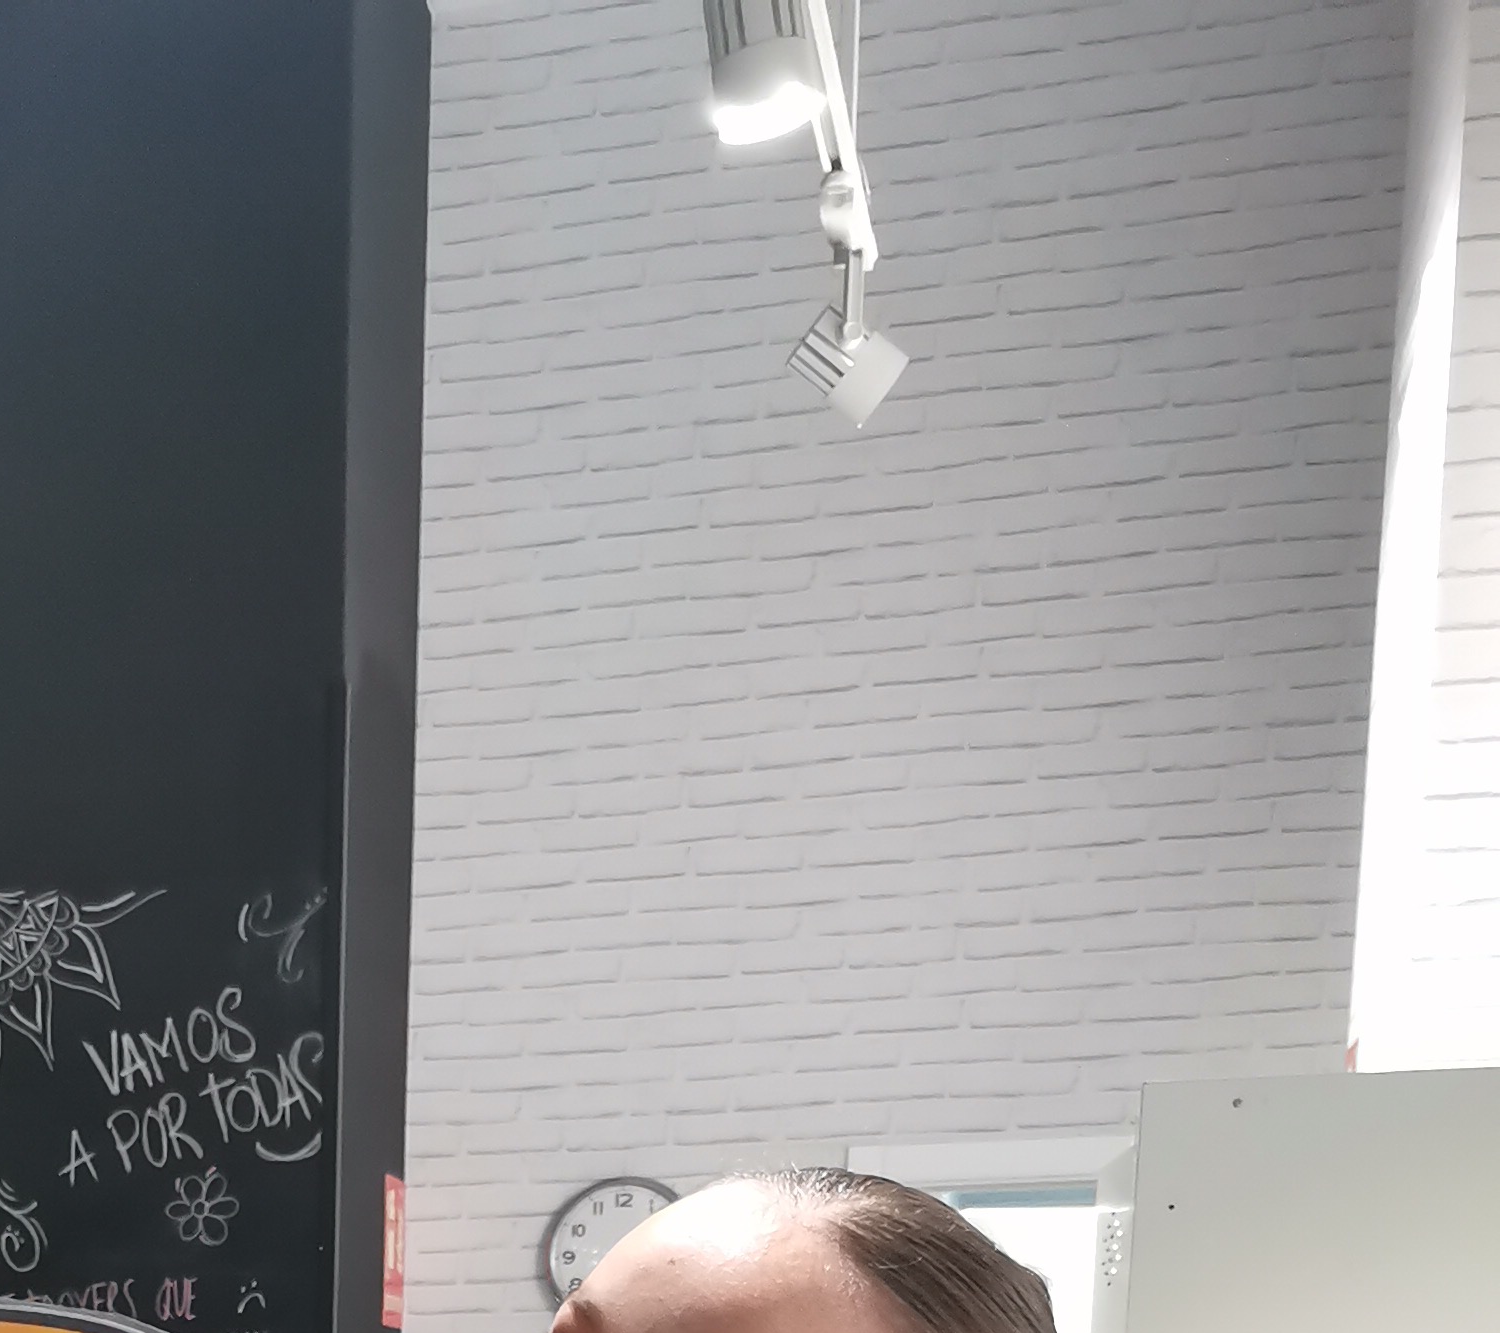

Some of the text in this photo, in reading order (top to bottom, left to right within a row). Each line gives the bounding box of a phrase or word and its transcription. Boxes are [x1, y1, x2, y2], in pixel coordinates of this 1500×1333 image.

[82, 987, 256, 1096] VAMOS
[58, 1032, 323, 1187] A POR TODAS
[615, 1193, 633, 1208] 12
[593, 1201, 604, 1216] 11
[571, 1224, 586, 1238] 10
[562, 1250, 576, 1265] 9
[155, 1276, 198, 1322] QUE
